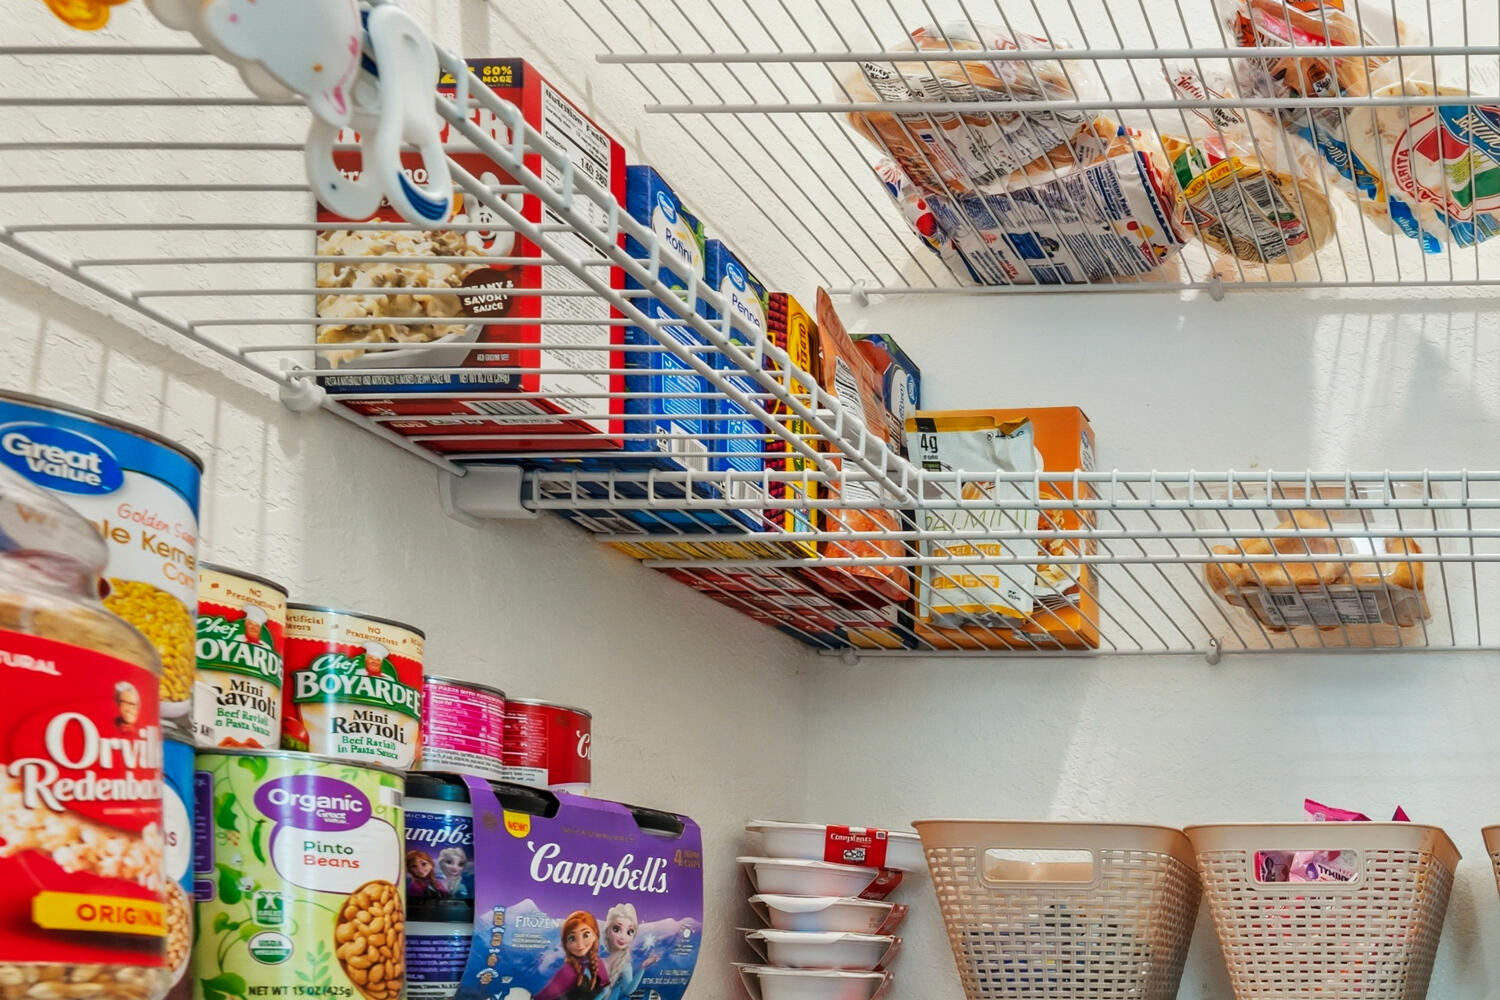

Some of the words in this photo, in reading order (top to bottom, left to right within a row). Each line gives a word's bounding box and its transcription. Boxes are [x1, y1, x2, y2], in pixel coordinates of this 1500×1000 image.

[482, 75, 512, 84] MORE
[483, 66, 512, 76] 60%
[665, 227, 693, 265] Rotini
[473, 302, 503, 314] SAUCE
[920, 432, 939, 453] 4g
[2, 432, 103, 474] Great
[25, 456, 103, 487] Value
[117, 503, 170, 534] Golden
[311, 652, 360, 675] Chef
[229, 678, 264, 698] Mini
[296, 671, 422, 716] BOYARDEE
[352, 709, 389, 725] Mini
[331, 716, 407, 746] Ravioli
[341, 735, 364, 746] Beef
[267, 787, 363, 813] Organic
[303, 840, 355, 856] Pinto
[303, 854, 361, 870] Beans
[527, 840, 669, 896] Campbell's
[515, 914, 561, 929] FROZEN
[248, 985, 269, 997] NET
[271, 985, 289, 997] WT
[292, 985, 304, 997] 15
[306, 985, 322, 997] OZ
[322, 984, 354, 998] (425g)
